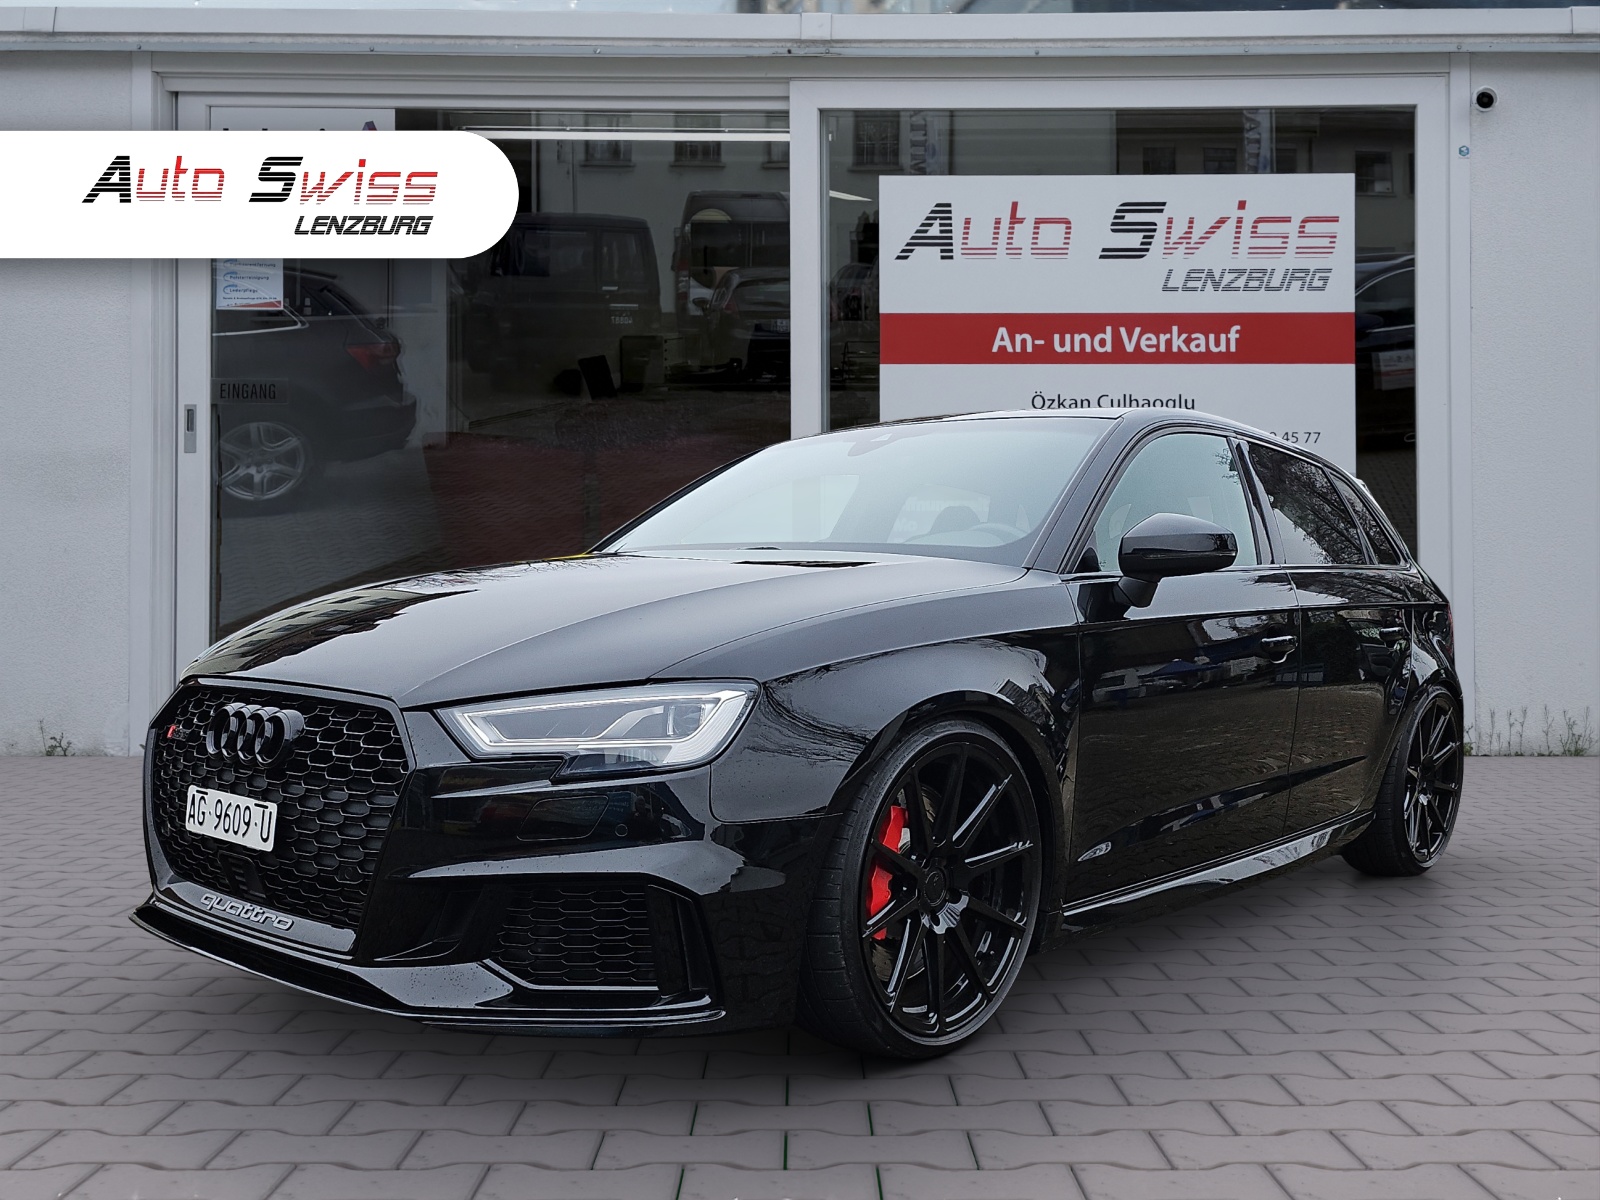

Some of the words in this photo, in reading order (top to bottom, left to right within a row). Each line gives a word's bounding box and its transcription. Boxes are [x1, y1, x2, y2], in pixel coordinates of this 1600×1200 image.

[894, 201, 1072, 260] Auto
[1098, 200, 1340, 259] Swiss
[1162, 268, 1333, 291] LENZBURG
[992, 327, 1044, 352] An-
[1054, 326, 1112, 352] und
[1119, 325, 1240, 352] Verkauf
[220, 383, 276, 399] EINGANG
[1032, 391, 1091, 409] Özkan
[1282, 431, 1299, 444] 45
[1304, 431, 1321, 444] 77
[201, 893, 294, 931] quattro
